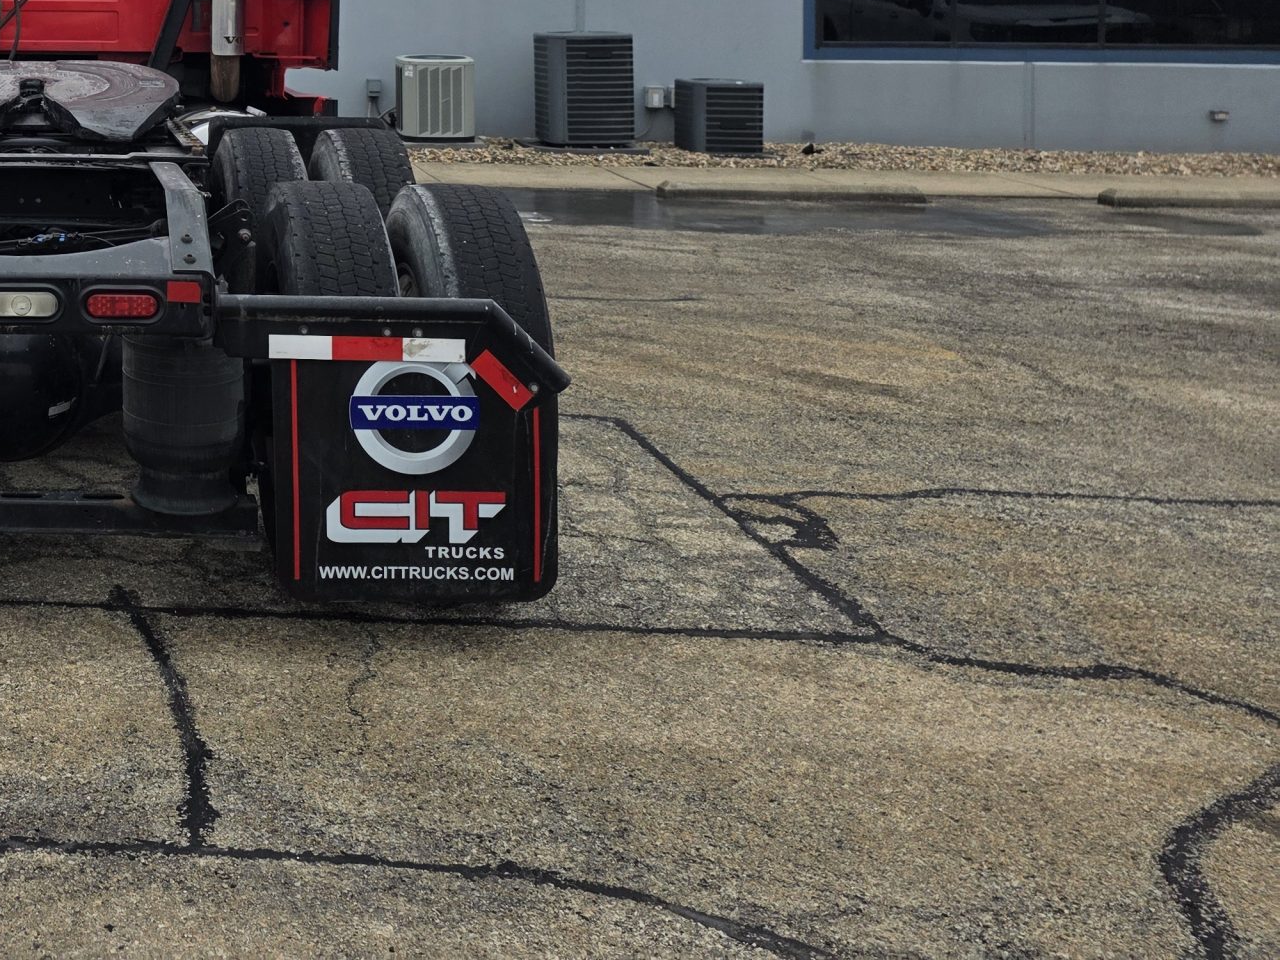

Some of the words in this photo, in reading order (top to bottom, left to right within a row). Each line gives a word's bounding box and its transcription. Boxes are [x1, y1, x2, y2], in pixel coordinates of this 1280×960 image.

[358, 404, 474, 422] VOLVO
[326, 489, 507, 544] CIT
[425, 546, 505, 560] TRUCKS
[319, 565, 515, 582] WWW.CITTRUCKS.COM
